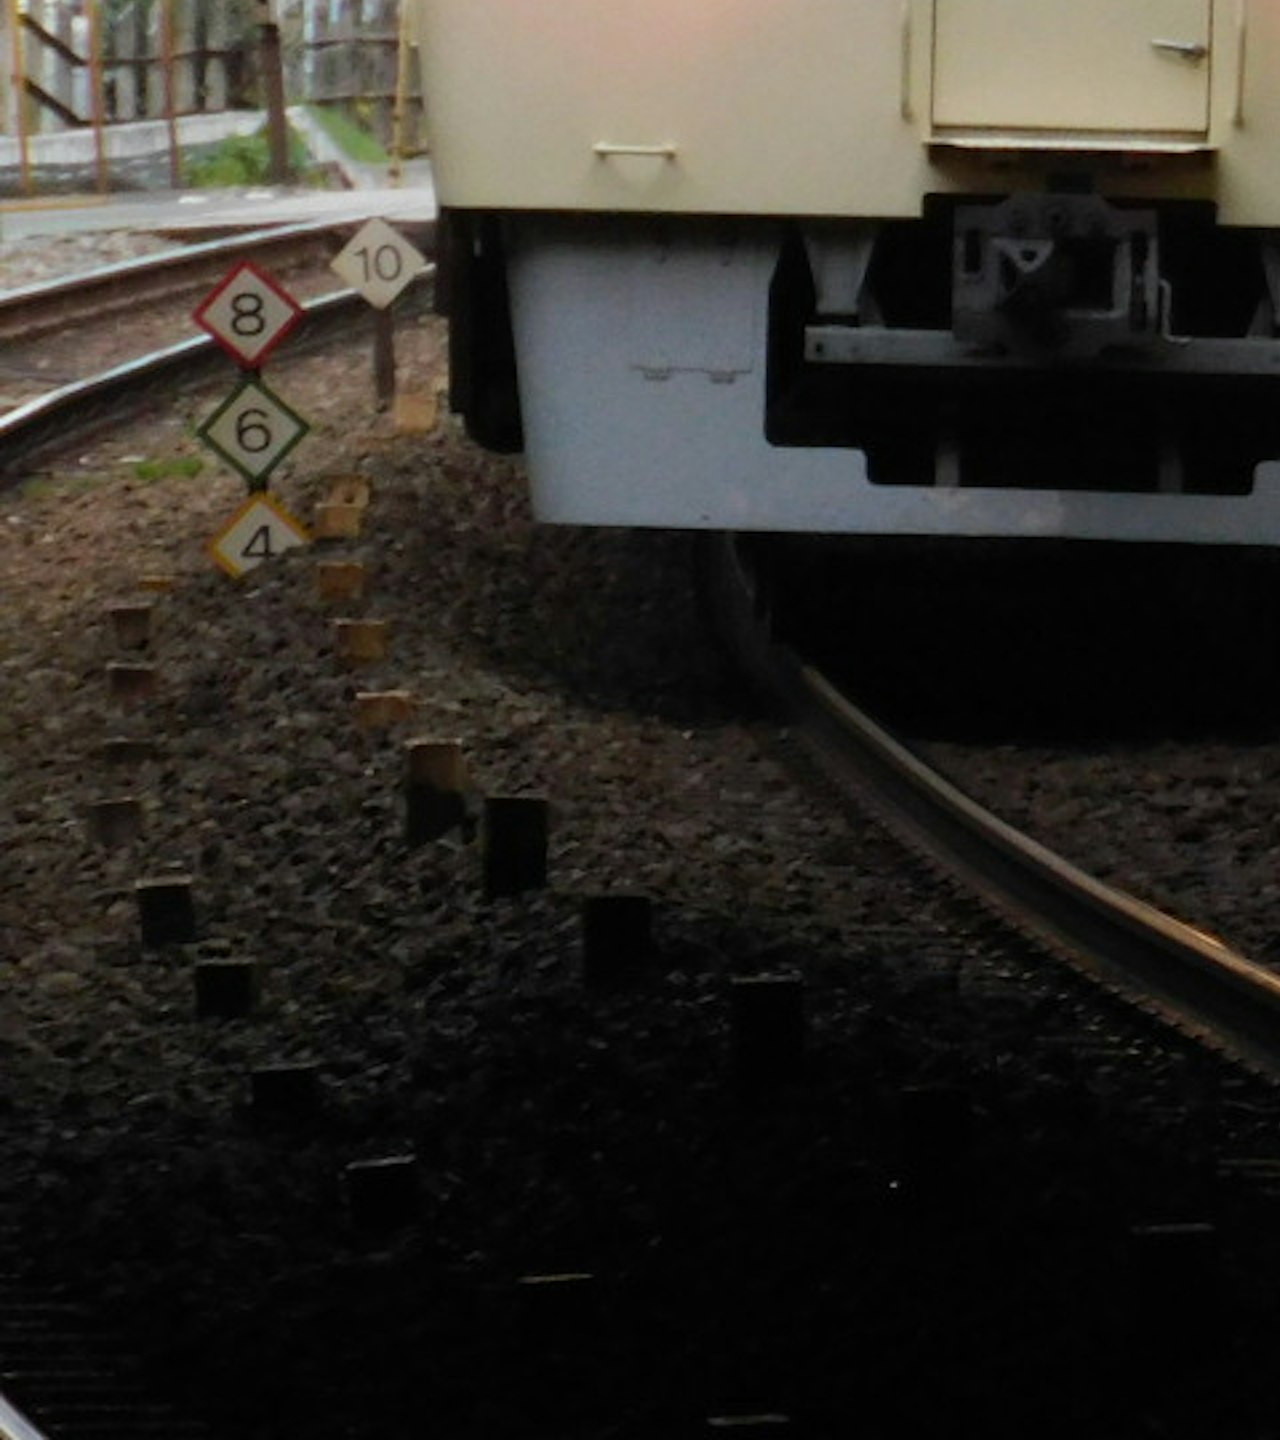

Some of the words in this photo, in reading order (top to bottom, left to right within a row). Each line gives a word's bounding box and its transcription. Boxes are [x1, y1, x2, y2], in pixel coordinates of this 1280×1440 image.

[353, 244, 403, 283] 10
[230, 292, 265, 337] 8
[234, 408, 272, 453] 6
[239, 525, 277, 561] 4
